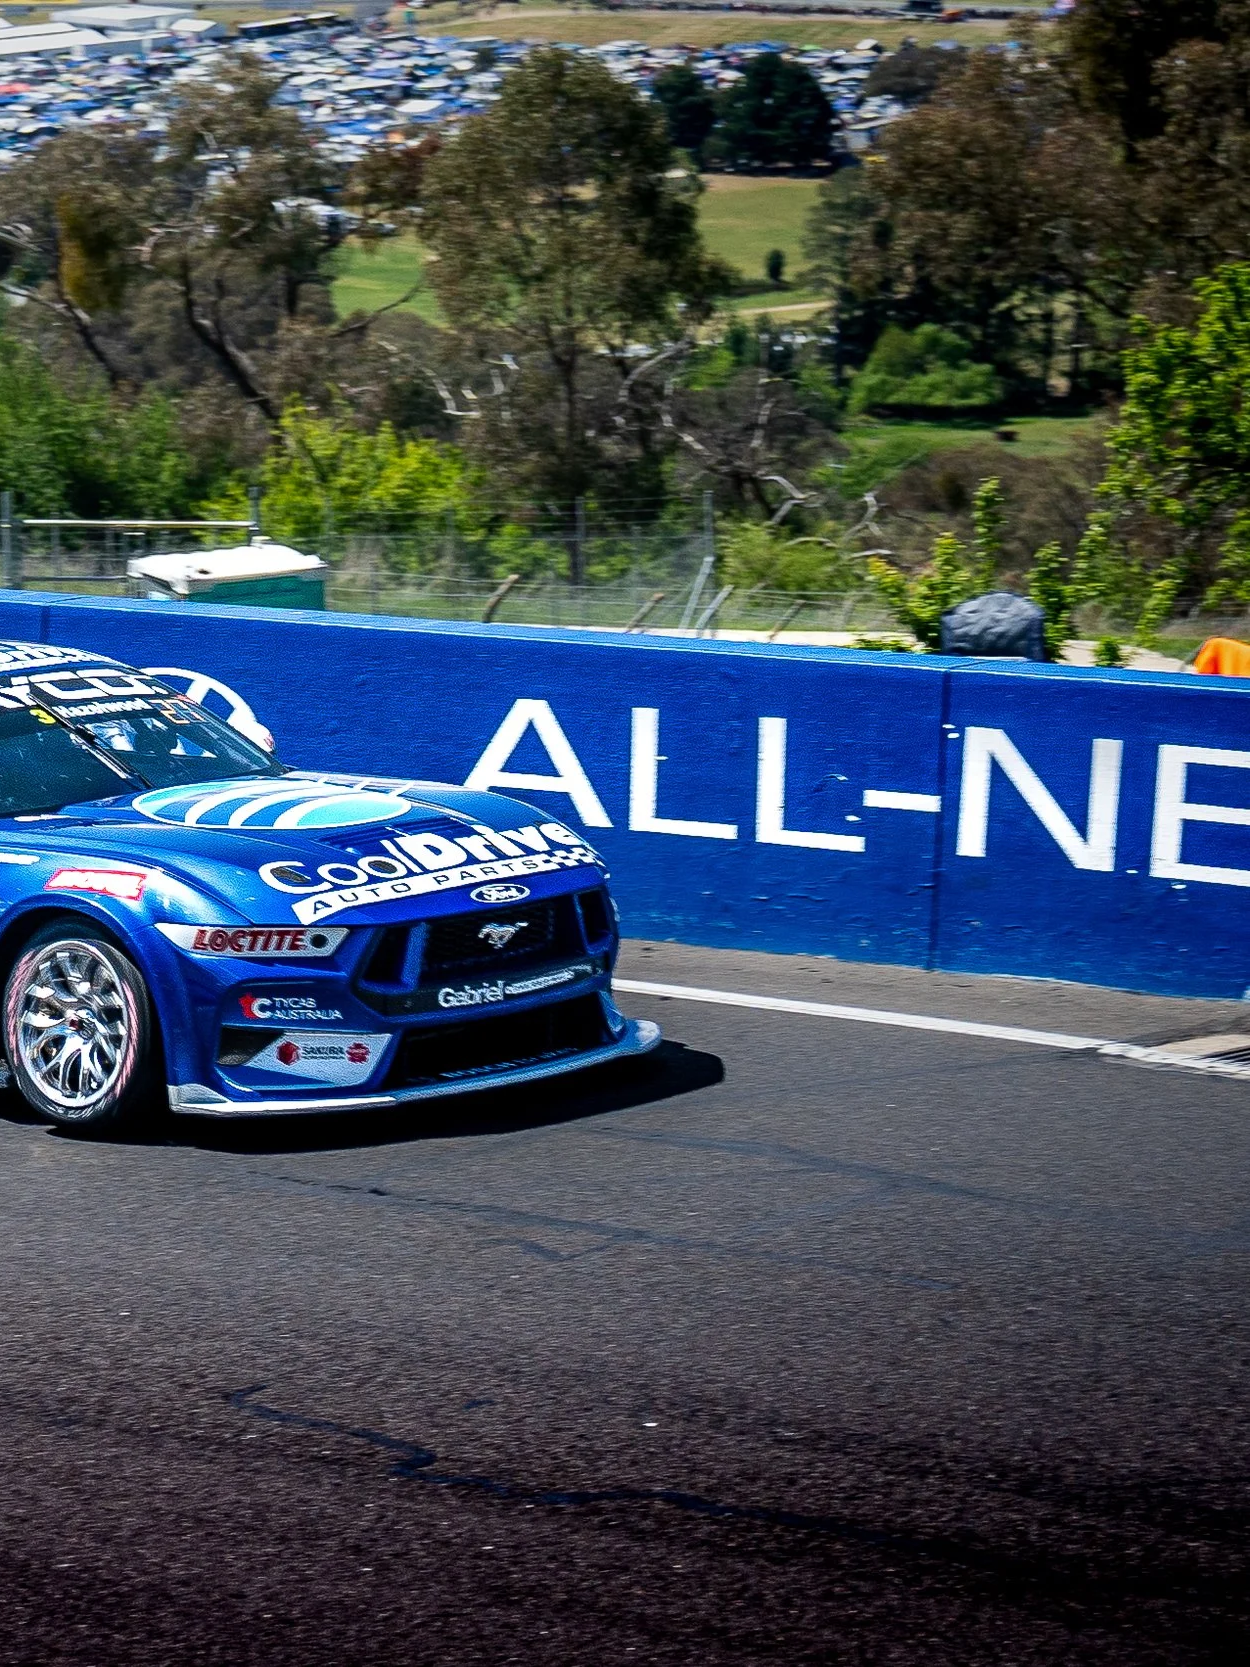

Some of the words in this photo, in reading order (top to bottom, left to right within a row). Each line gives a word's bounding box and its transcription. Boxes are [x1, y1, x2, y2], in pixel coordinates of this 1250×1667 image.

[29, 708, 57, 725] 3
[258, 822, 582, 895] CoolDrive
[311, 882, 412, 915] AUTO
[432, 857, 543, 886] PARTS
[192, 929, 308, 953] LOCTITE
[438, 980, 506, 1008] Gabriel
